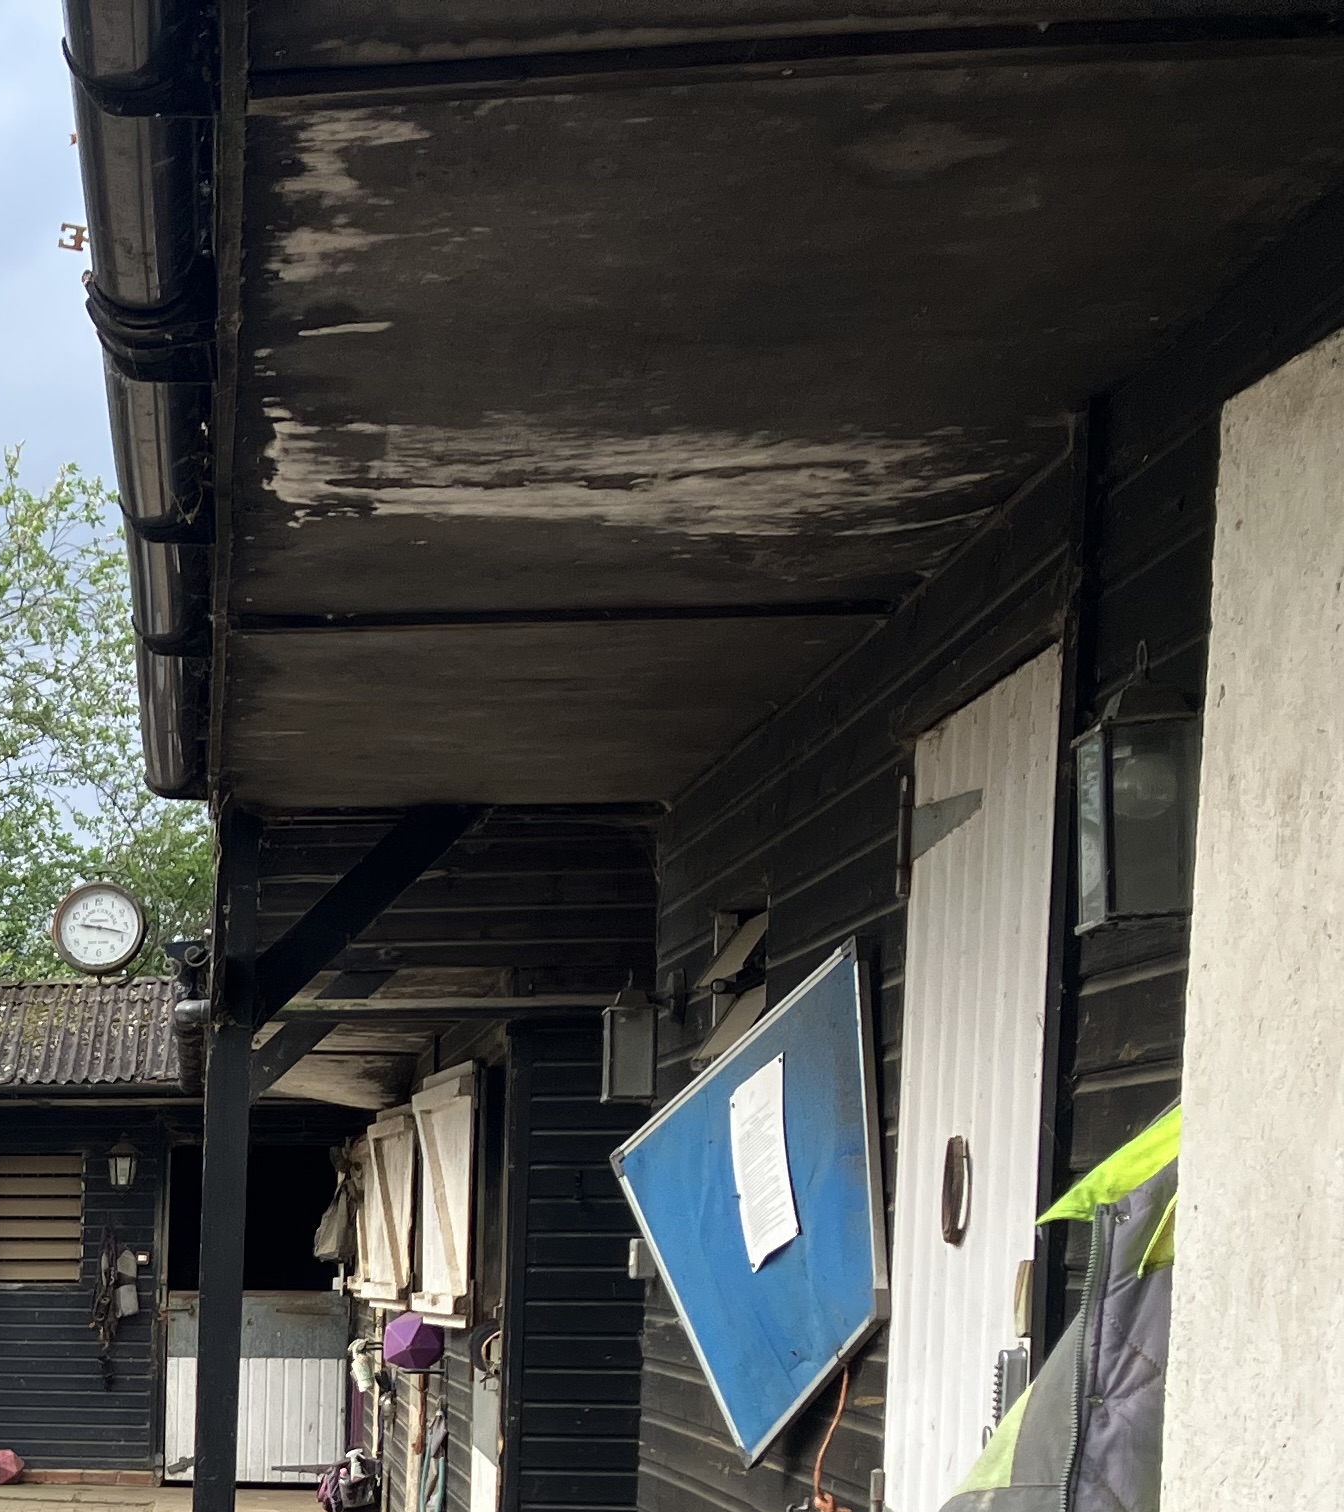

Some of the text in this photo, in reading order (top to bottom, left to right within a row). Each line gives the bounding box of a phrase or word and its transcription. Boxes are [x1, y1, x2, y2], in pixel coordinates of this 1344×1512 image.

[94, 897, 104, 906] 12
[82, 902, 89, 911] 11
[72, 911, 81, 920] 10
[119, 908, 126, 917] 2
[68, 924, 76, 933] 9
[123, 921, 129, 931] 3
[73, 938, 80, 946] 8
[95, 948, 102, 957] 6
[109, 944, 116, 953] 5
